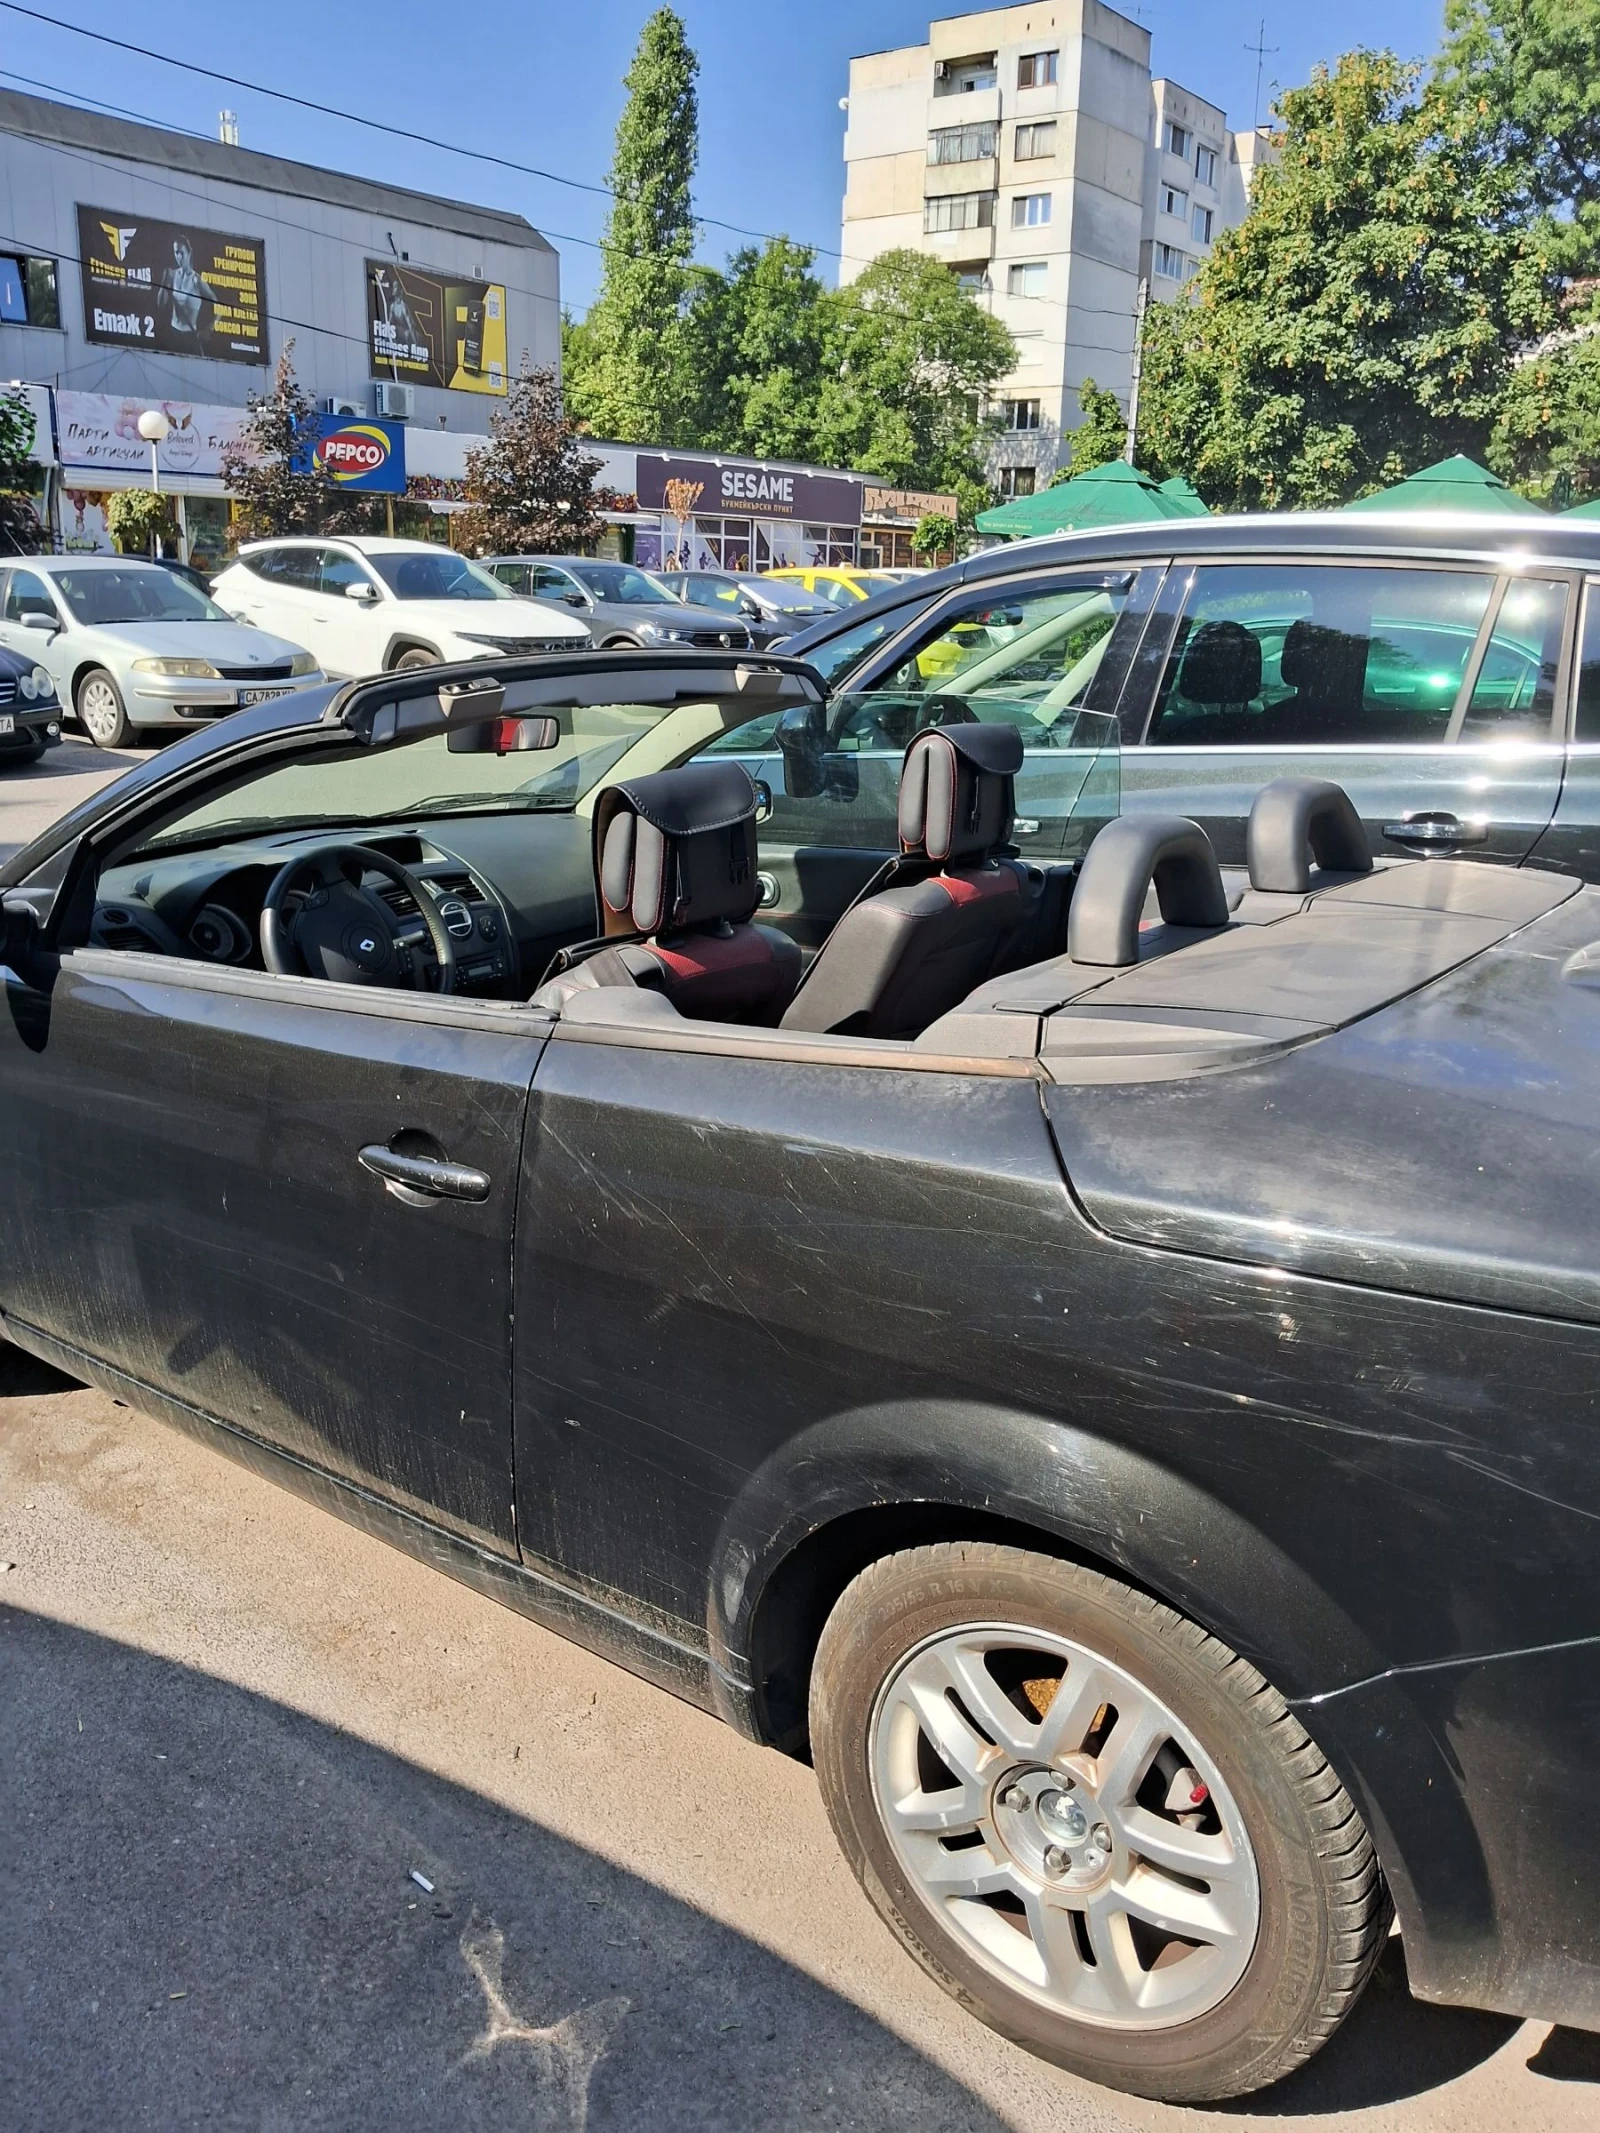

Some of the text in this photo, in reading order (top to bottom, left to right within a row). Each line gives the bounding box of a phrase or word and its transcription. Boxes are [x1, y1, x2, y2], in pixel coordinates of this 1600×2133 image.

[90, 256, 126, 278] FITNESS
[213, 257, 256, 275] ТРЕНИРОВКИ
[200, 271, 257, 291] ФУНКЦИОНАЛНА
[239, 291, 257, 305] ЗОНА
[144, 315, 155, 338] 2
[214, 320, 259, 338] БОКСОВ РИНГ
[373, 320, 397, 339] Flais
[375, 338, 429, 362] Fitness App
[325, 441, 380, 464] PEPCO
[721, 471, 794, 502] SESAME
[721, 499, 793, 514] БУКМЕЙКЪРСКИ ПУНКТ
[928, 1582, 943, 1598] R
[945, 1579, 965, 1594] 16
[954, 1986, 975, 2005] 4
